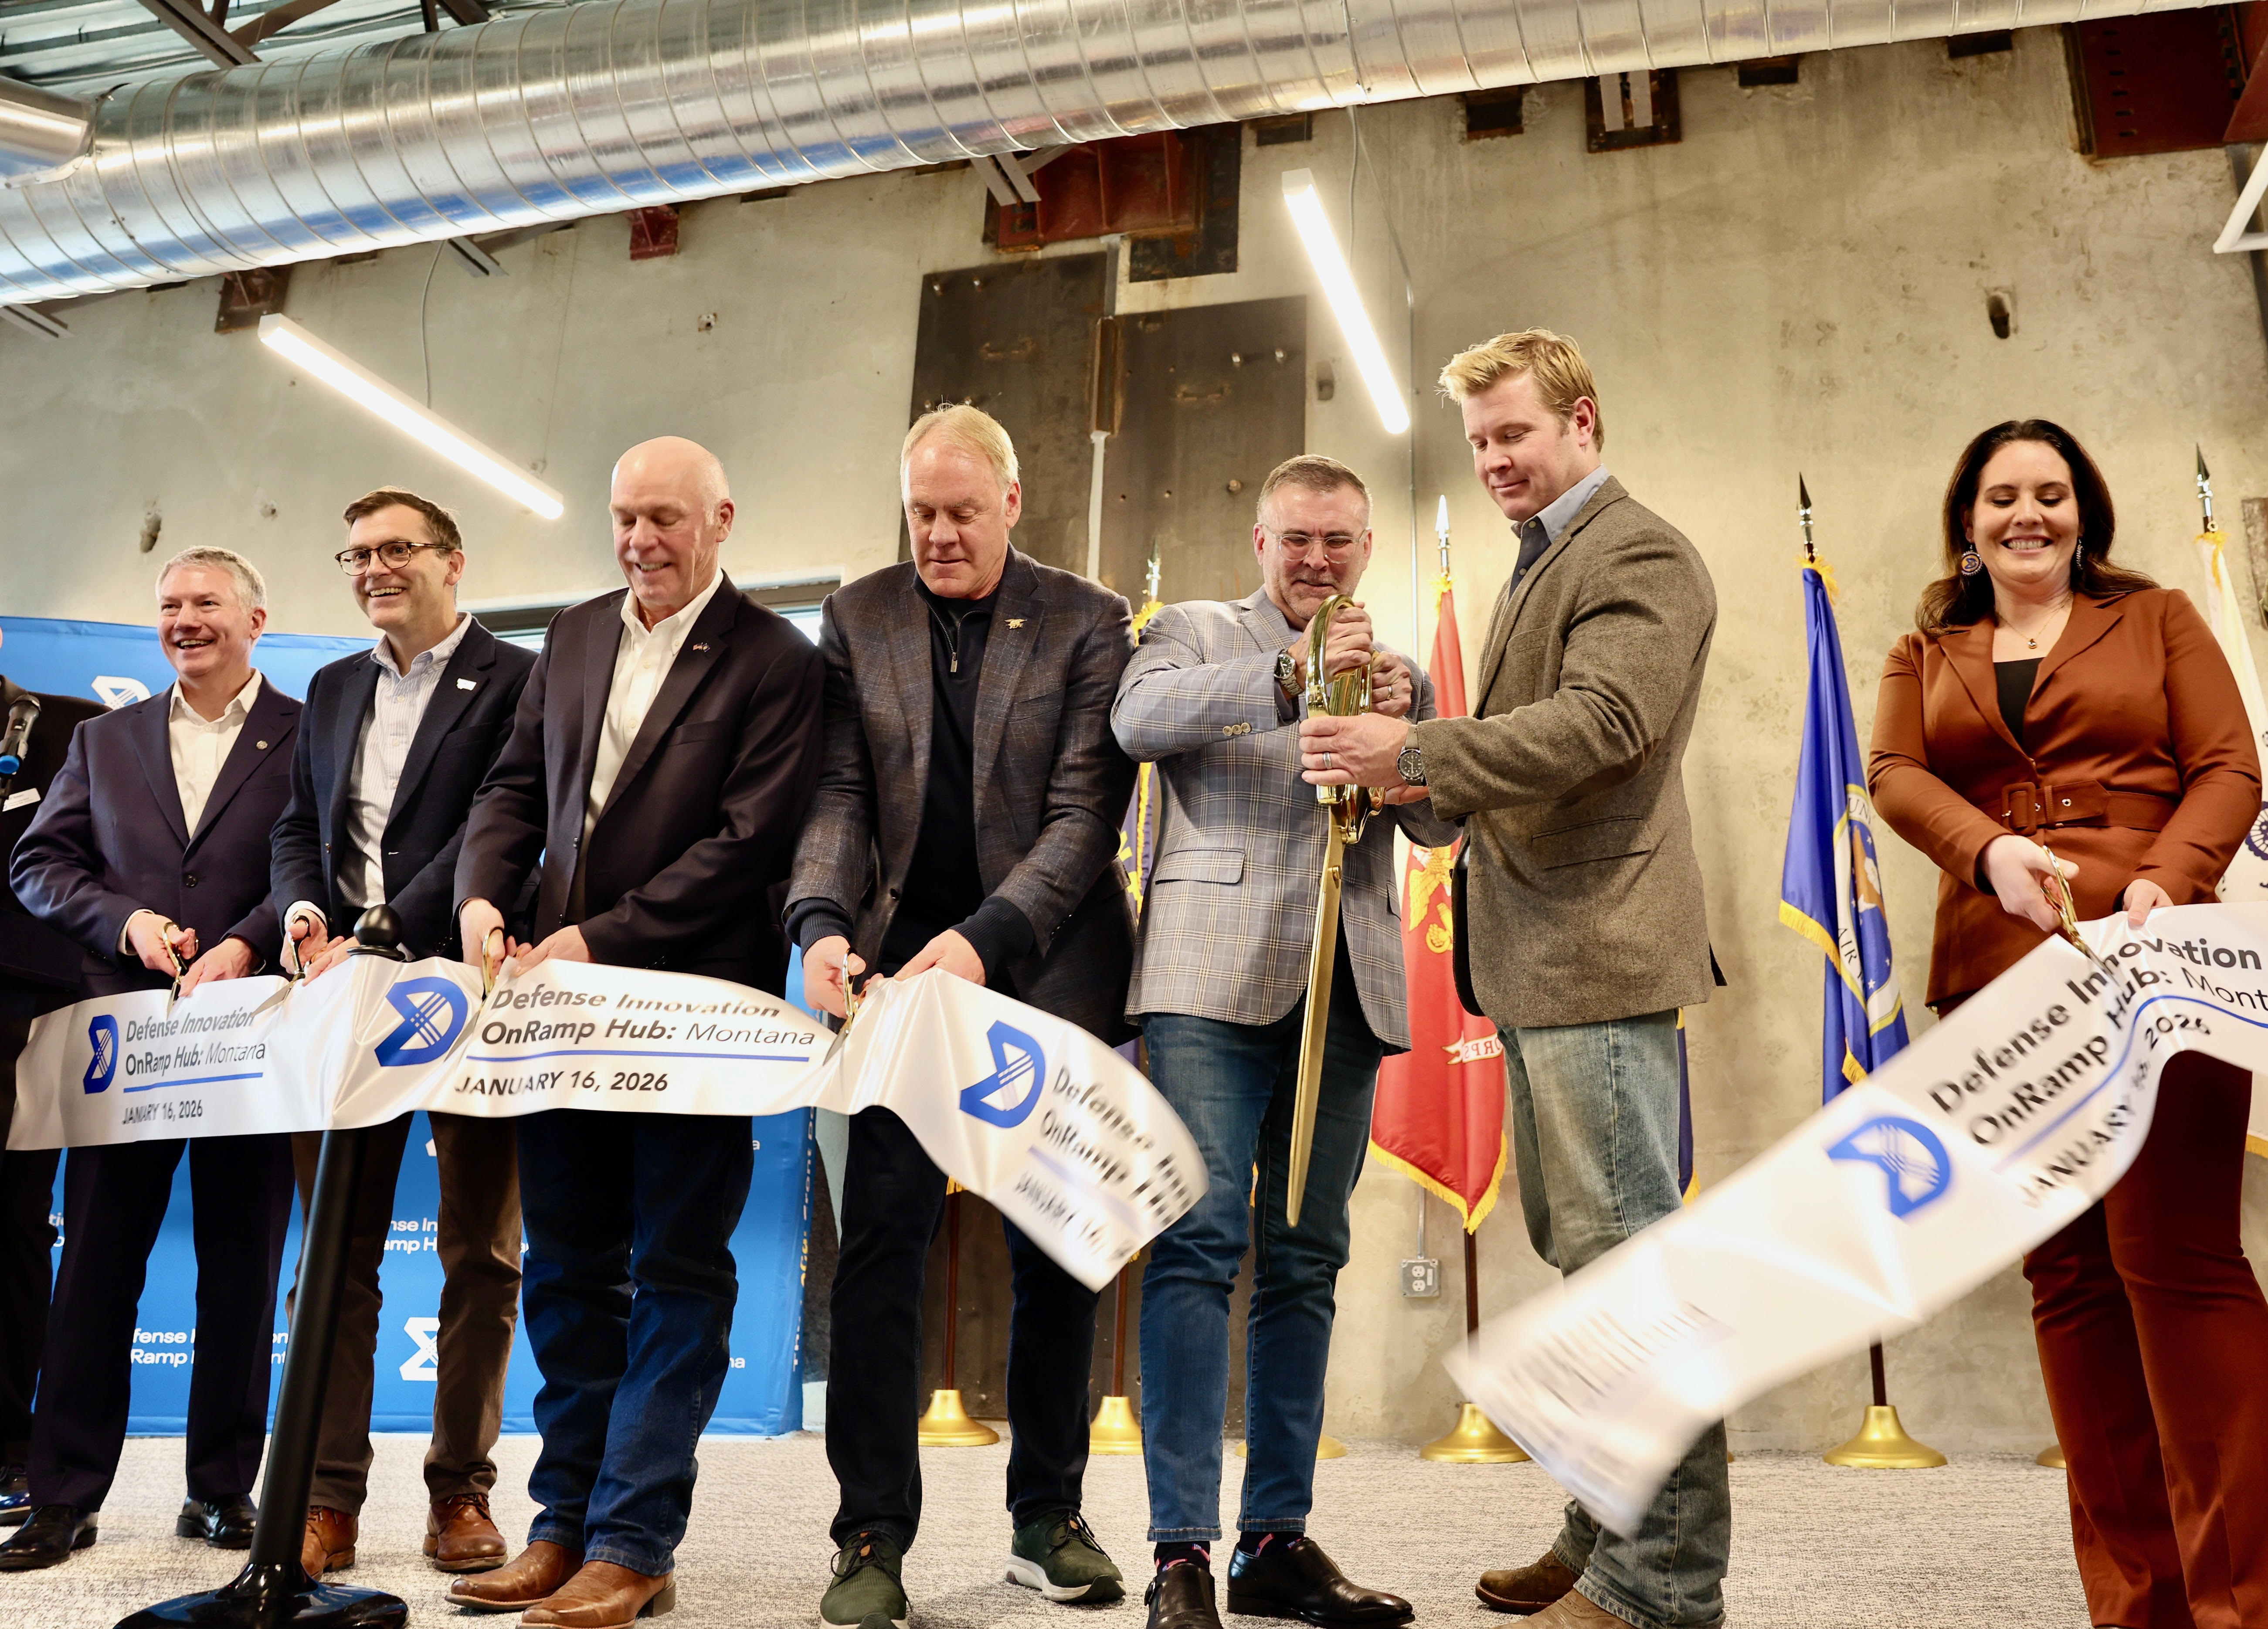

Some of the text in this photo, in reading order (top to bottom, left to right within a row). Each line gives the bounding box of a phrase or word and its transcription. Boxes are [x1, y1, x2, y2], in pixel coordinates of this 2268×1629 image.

[491, 983, 781, 1018] Defense Innovation
[126, 1006, 255, 1042] Defense Innovation
[482, 1018, 815, 1045] OnRamp Hub: Montana
[126, 1041, 265, 1077] OnRamp Hub: Montana
[1931, 1004, 2071, 1113] Defense
[455, 1071, 668, 1096] JANUARY 16, 2026
[1969, 1035, 2107, 1144] OnRamp
[162, 1102, 175, 1122] 16,
[179, 1099, 203, 1119] 2026
